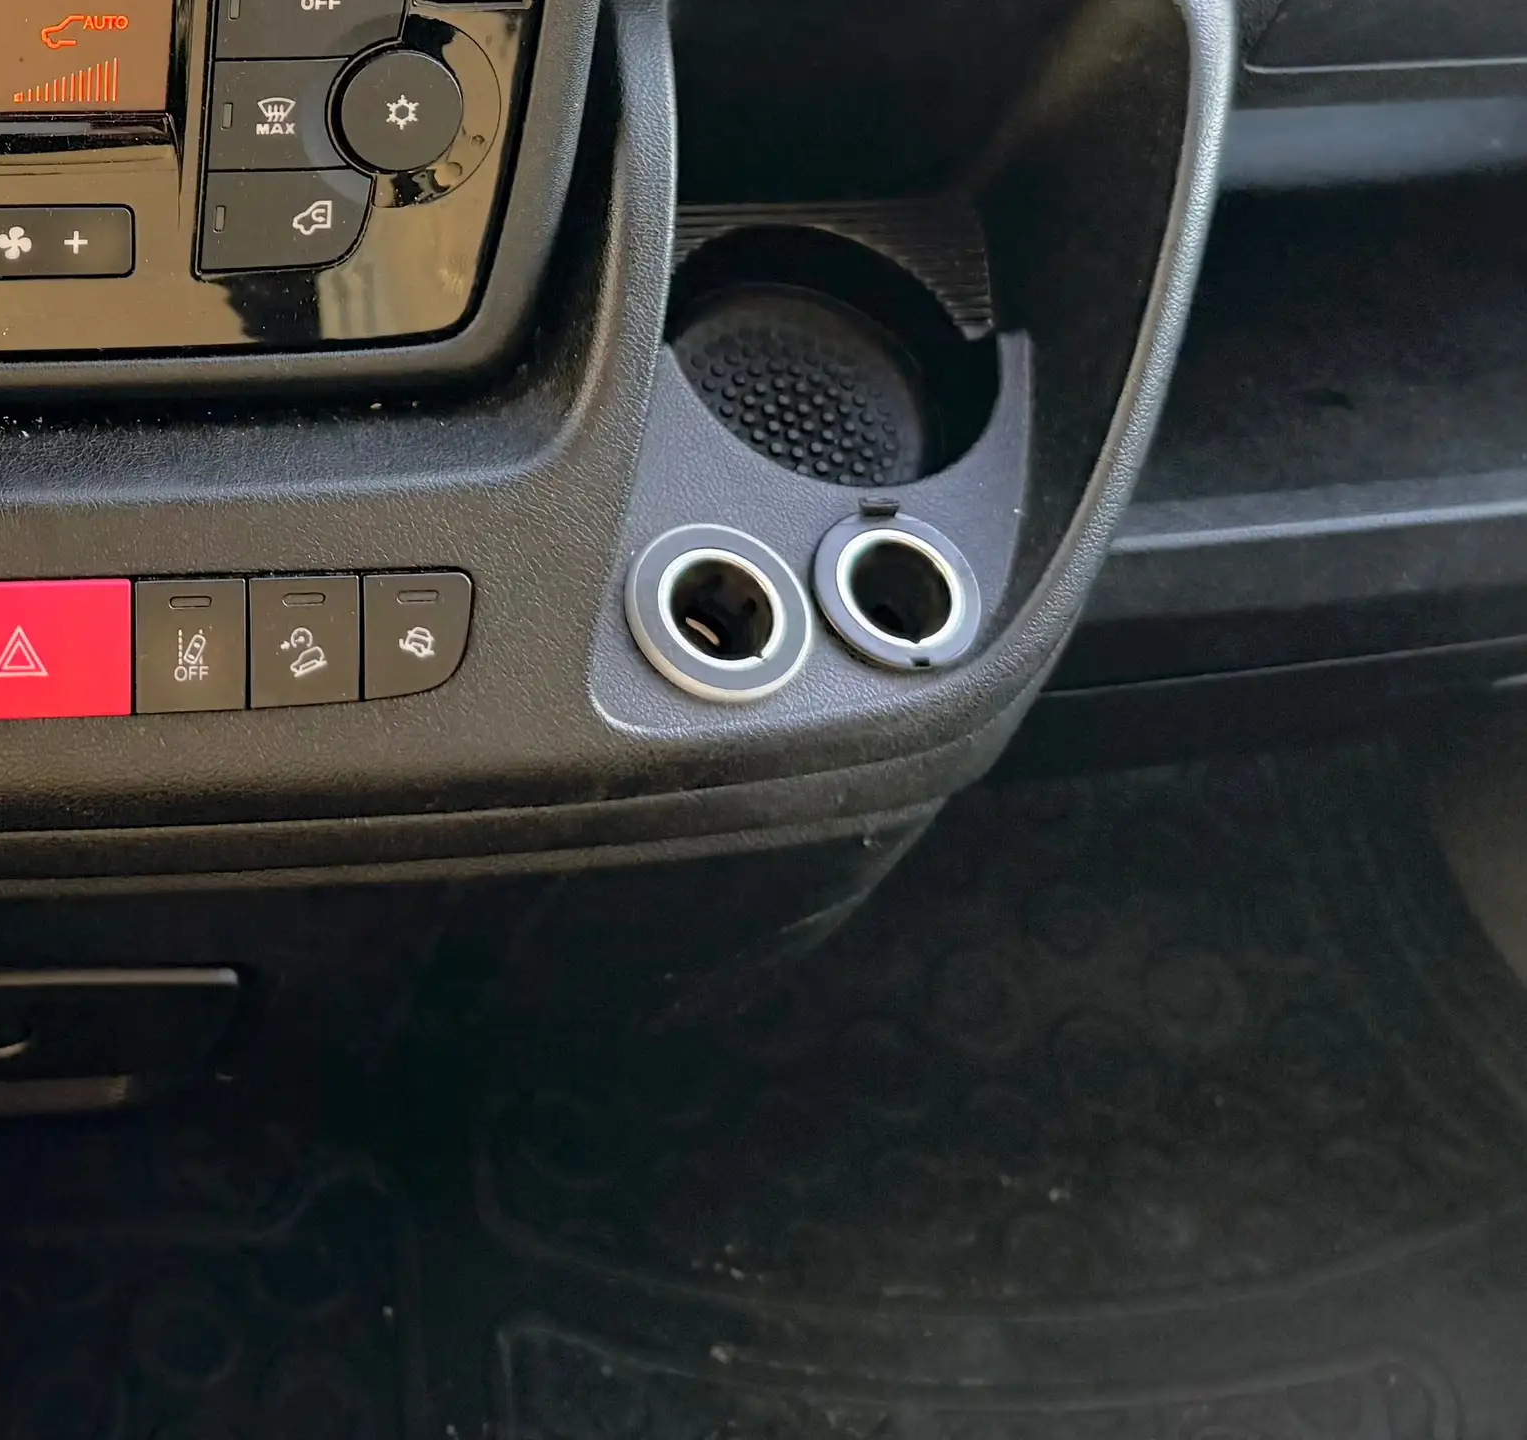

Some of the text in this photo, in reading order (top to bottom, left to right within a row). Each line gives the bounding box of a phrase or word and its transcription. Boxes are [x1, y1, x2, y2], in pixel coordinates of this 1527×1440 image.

[83, 15, 129, 30] AUTO
[256, 123, 295, 135] MAX
[174, 665, 209, 681] OFF
